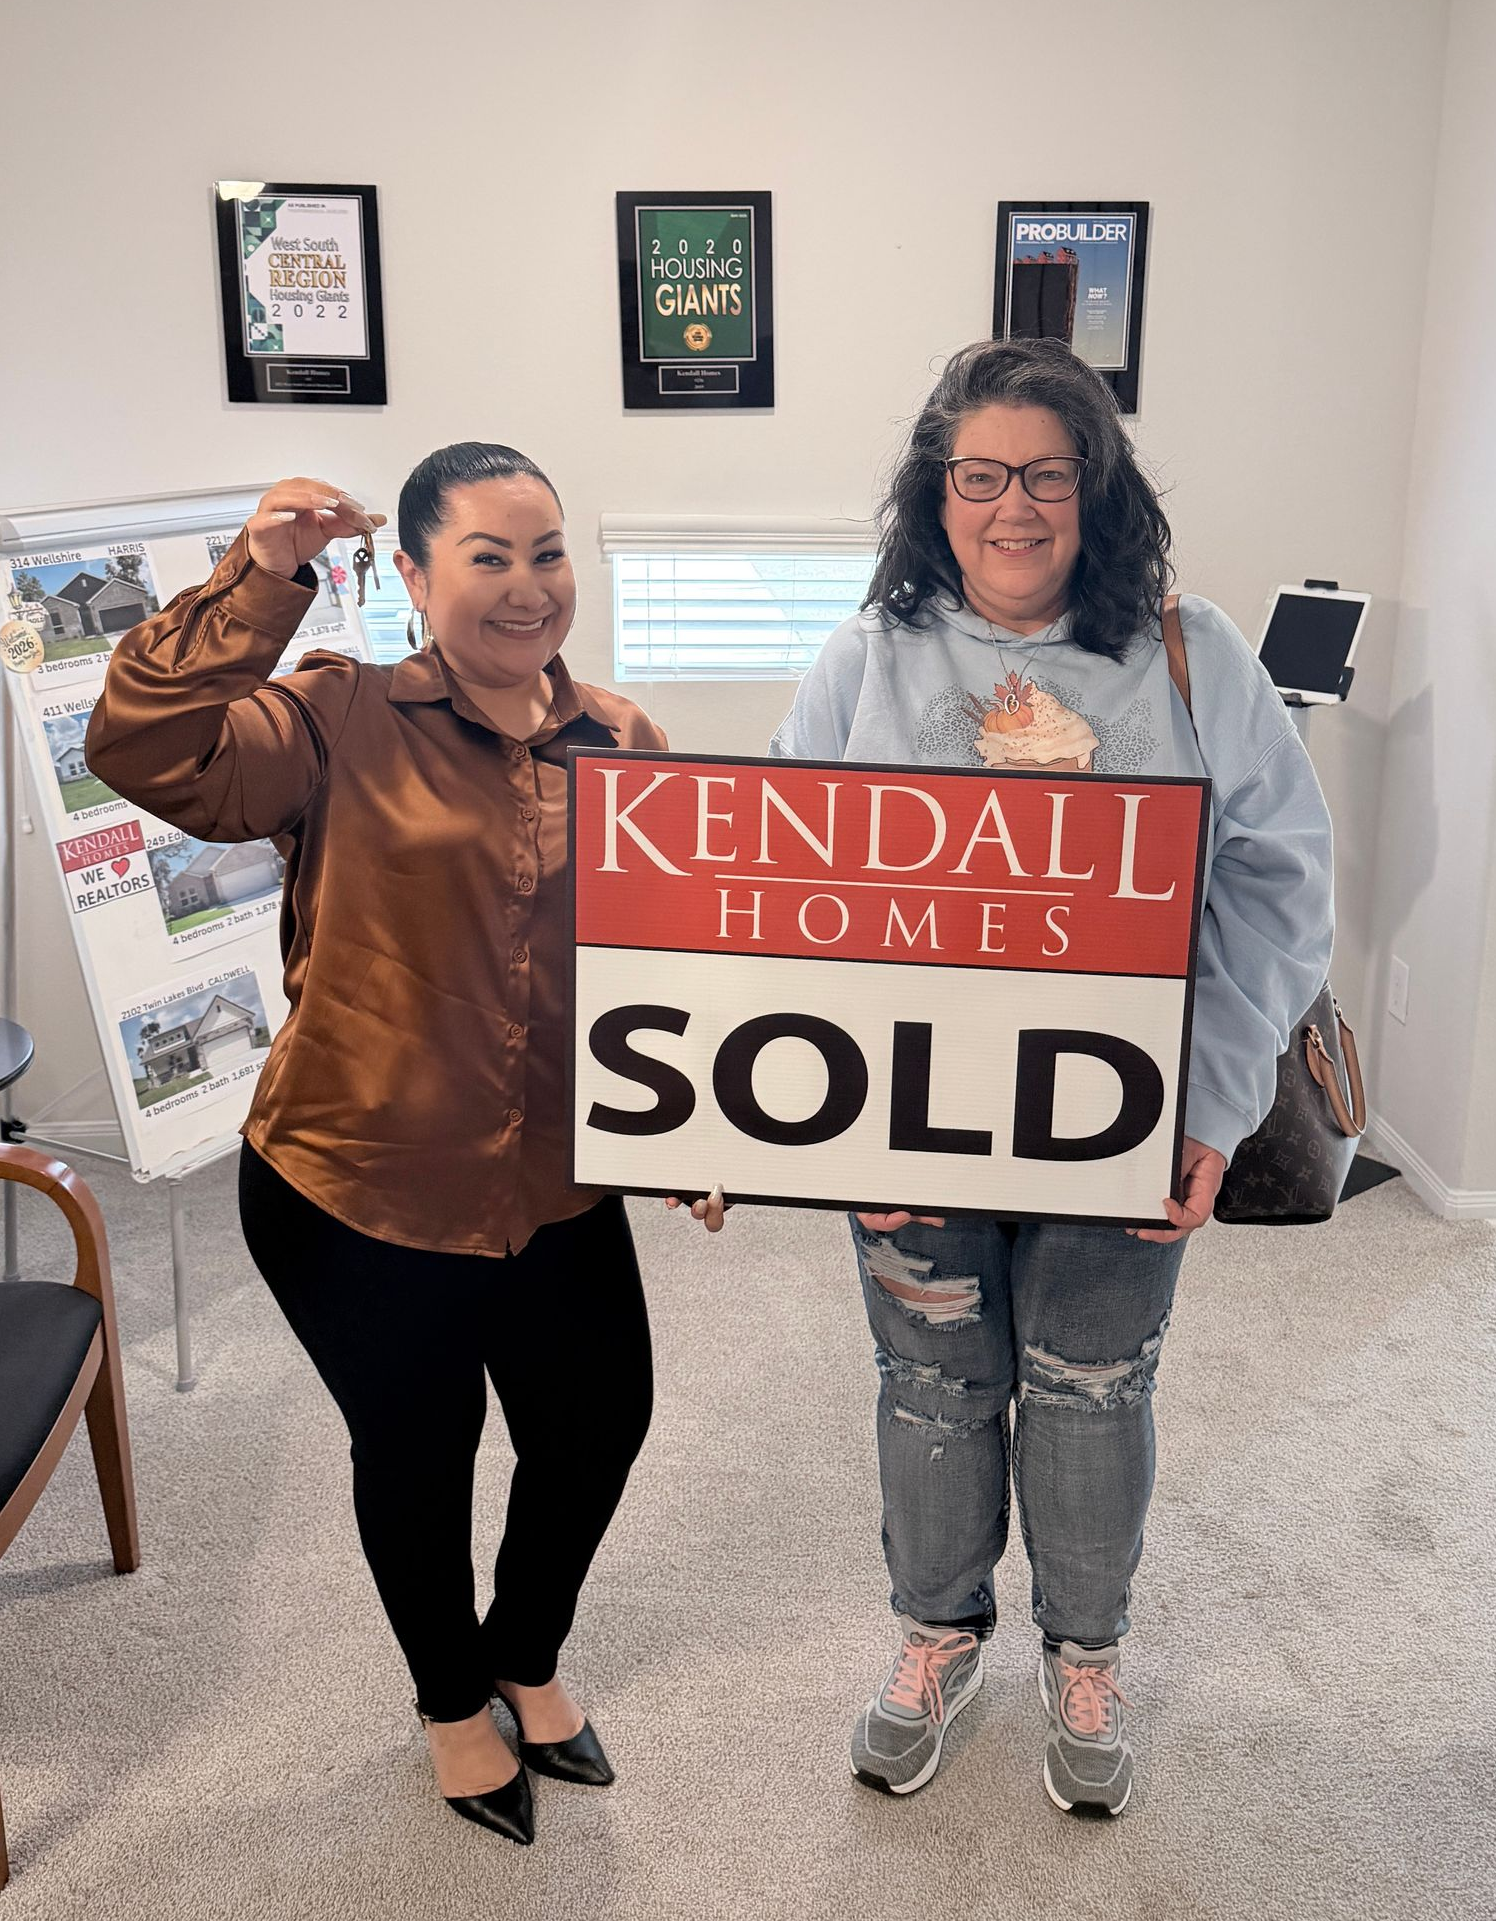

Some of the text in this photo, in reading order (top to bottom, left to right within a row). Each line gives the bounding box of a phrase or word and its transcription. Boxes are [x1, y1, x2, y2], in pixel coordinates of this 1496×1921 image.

[1016, 223, 1127, 241] PROBUILDER
[271, 237, 339, 252] West South
[651, 238, 742, 255] 2020
[268, 253, 346, 270] CENTRAL
[651, 257, 743, 279] HOUSING
[269, 269, 347, 288] REGION
[269, 289, 350, 304] Housing Giants
[655, 283, 743, 316] GIANTS
[272, 303, 348, 319] 2022
[205, 535, 222, 546] 221
[10, 543, 146, 569] 314 Wellshire HARRIS
[7, 637, 35, 660] 2026
[37, 665, 45, 674] 3
[45, 657, 93, 673] bedrooms
[96, 654, 103, 663] 2
[43, 705, 63, 717] 411
[73, 800, 128, 821] 4 bedrooms
[61, 824, 140, 861] KENDALL
[146, 835, 166, 849] 249
[593, 768, 1177, 902] KENDALL
[82, 844, 130, 866] HOMES
[80, 868, 106, 886] WE
[77, 874, 150, 909] REALTORS
[173, 936, 180, 945] 4
[180, 921, 225, 943] bedrooms
[226, 917, 233, 926] 2
[234, 910, 254, 923] bath
[715, 887, 1072, 957] HOMES
[121, 965, 250, 1020] 2102 Twin Lakes Blvd CALDWELL
[145, 1109, 152, 1118] 4
[153, 1090, 199, 1116] bedrooms
[201, 1085, 208, 1094] 2
[209, 1076, 230, 1091] bath
[232, 1065, 255, 1081] 1,691
[586, 1003, 1165, 1162] SOLD
